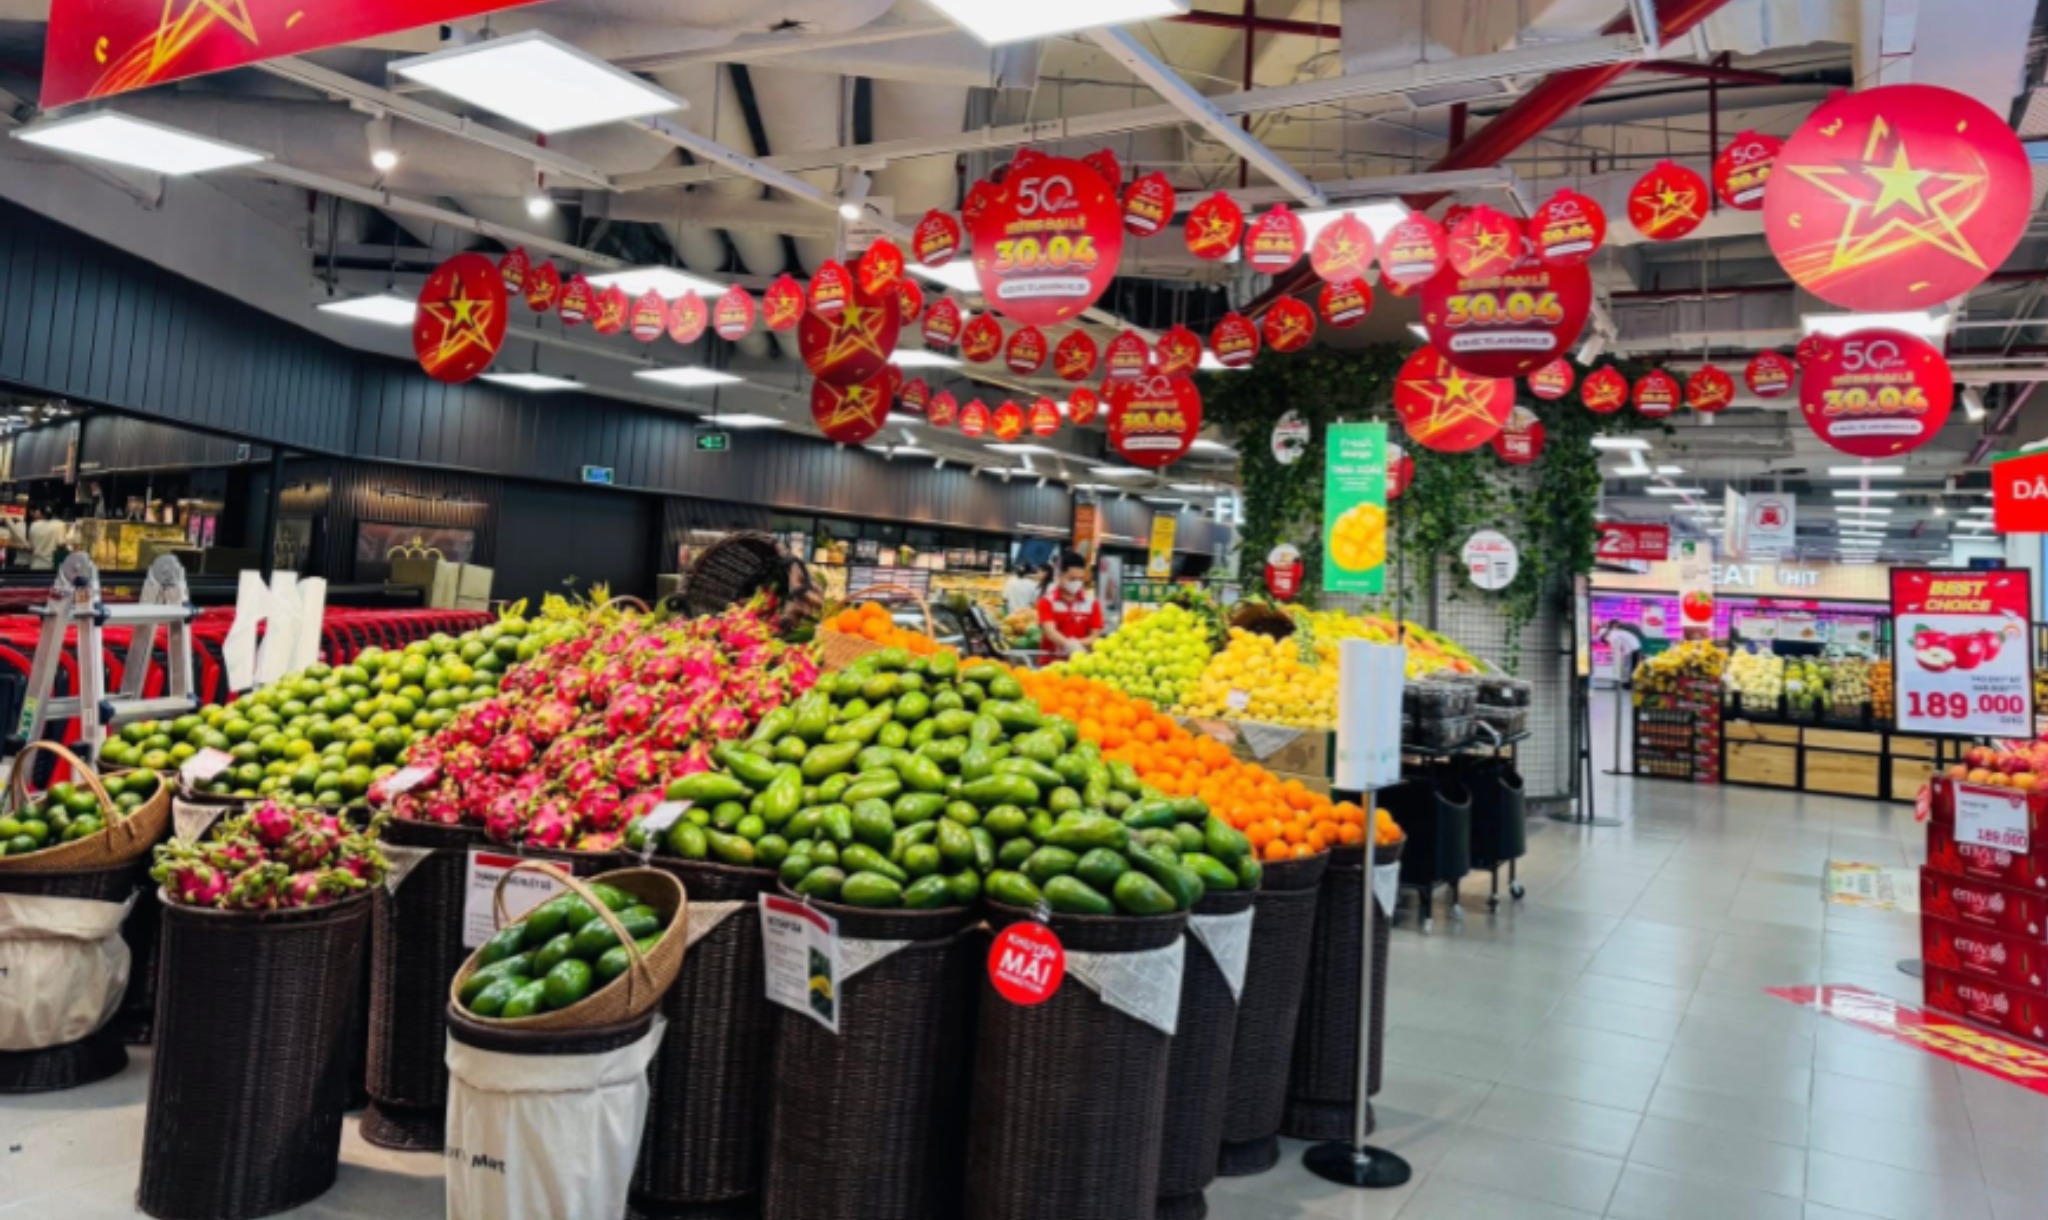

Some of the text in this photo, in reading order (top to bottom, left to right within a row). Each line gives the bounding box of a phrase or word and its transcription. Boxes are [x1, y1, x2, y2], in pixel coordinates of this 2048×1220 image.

[1016, 175, 1074, 216] 50
[994, 236, 1098, 273] 30.04
[1445, 292, 1565, 328] 30.04
[1841, 340, 1901, 371] 50
[1822, 387, 1929, 417] 30.04
[1928, 580, 1989, 597] BEST
[1924, 599, 1993, 613] CHOICE
